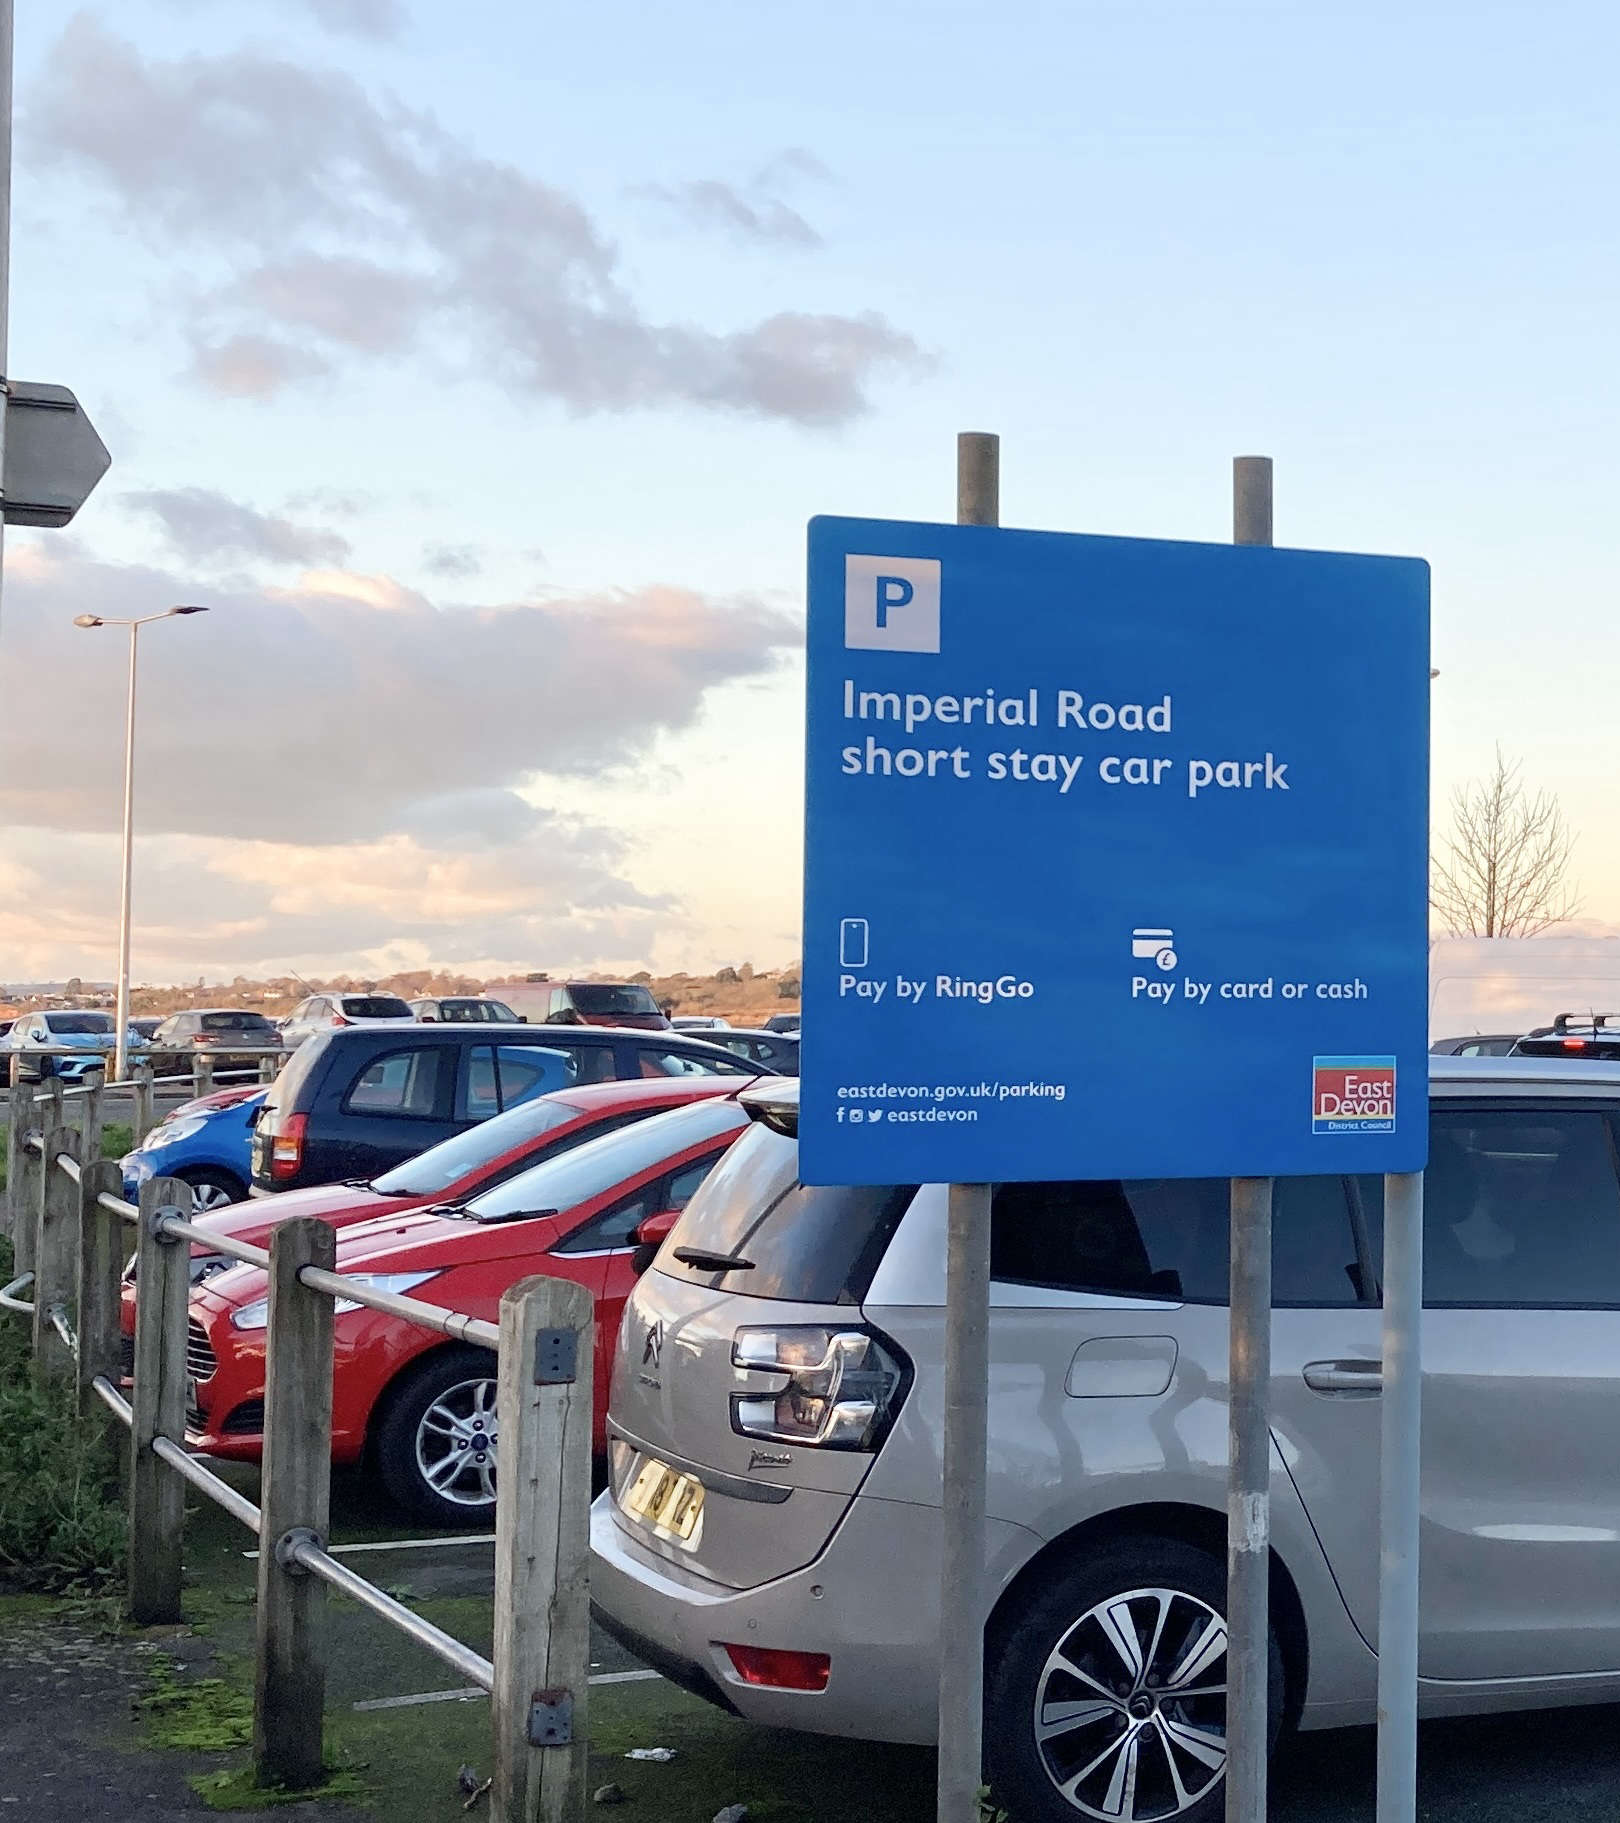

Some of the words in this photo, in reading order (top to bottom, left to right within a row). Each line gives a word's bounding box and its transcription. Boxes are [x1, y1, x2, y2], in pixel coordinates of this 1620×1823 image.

[876, 576, 913, 628] P
[843, 680, 1038, 734] Imperial
[1058, 690, 1172, 733] Road
[842, 737, 970, 779] short
[987, 749, 1083, 793] stay
[1099, 755, 1172, 785] car
[1188, 752, 1290, 797] park
[839, 974, 887, 1004] Pay
[896, 976, 927, 1004] by
[936, 975, 1035, 1004] RingGo
[1132, 977, 1176, 1004] Pay
[1184, 977, 1212, 1004] by
[1219, 977, 1273, 999] card
[1281, 983, 1309, 999] or
[1316, 978, 1368, 999] cash
[837, 1081, 1066, 1102] eastdevon.gov.uk/parking
[1344, 1075, 1392, 1098] East
[887, 1107, 978, 1123] eastdevon
[1320, 1093, 1392, 1117] Devon
[1328, 1121, 1359, 1130] District
[1361, 1120, 1392, 1130] Council
